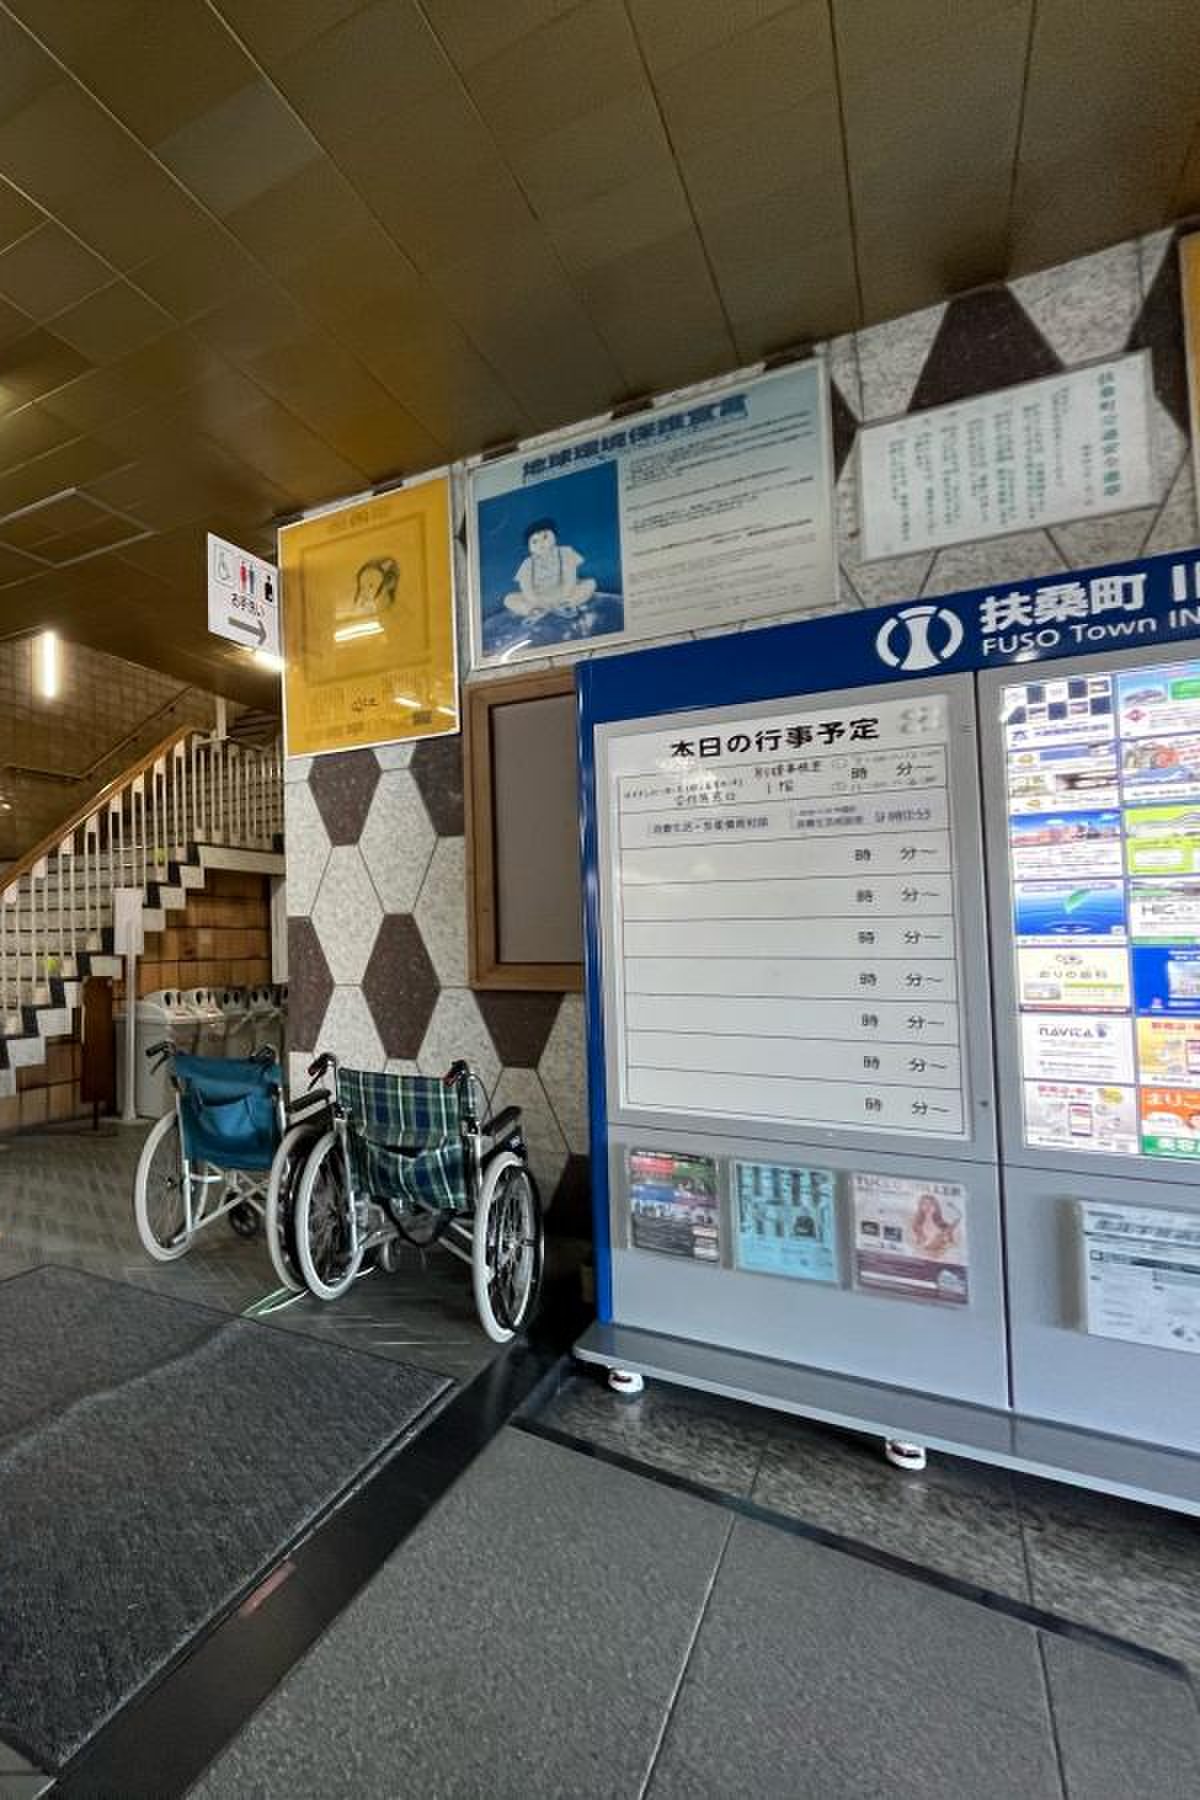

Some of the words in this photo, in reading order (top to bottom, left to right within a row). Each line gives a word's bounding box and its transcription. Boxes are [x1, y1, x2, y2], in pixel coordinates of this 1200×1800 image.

[979, 573, 1147, 633] 扶桑町
[982, 629, 1060, 656] FUSO
[1071, 617, 1156, 644] Town
[671, 717, 880, 758] 本日の行事予定
